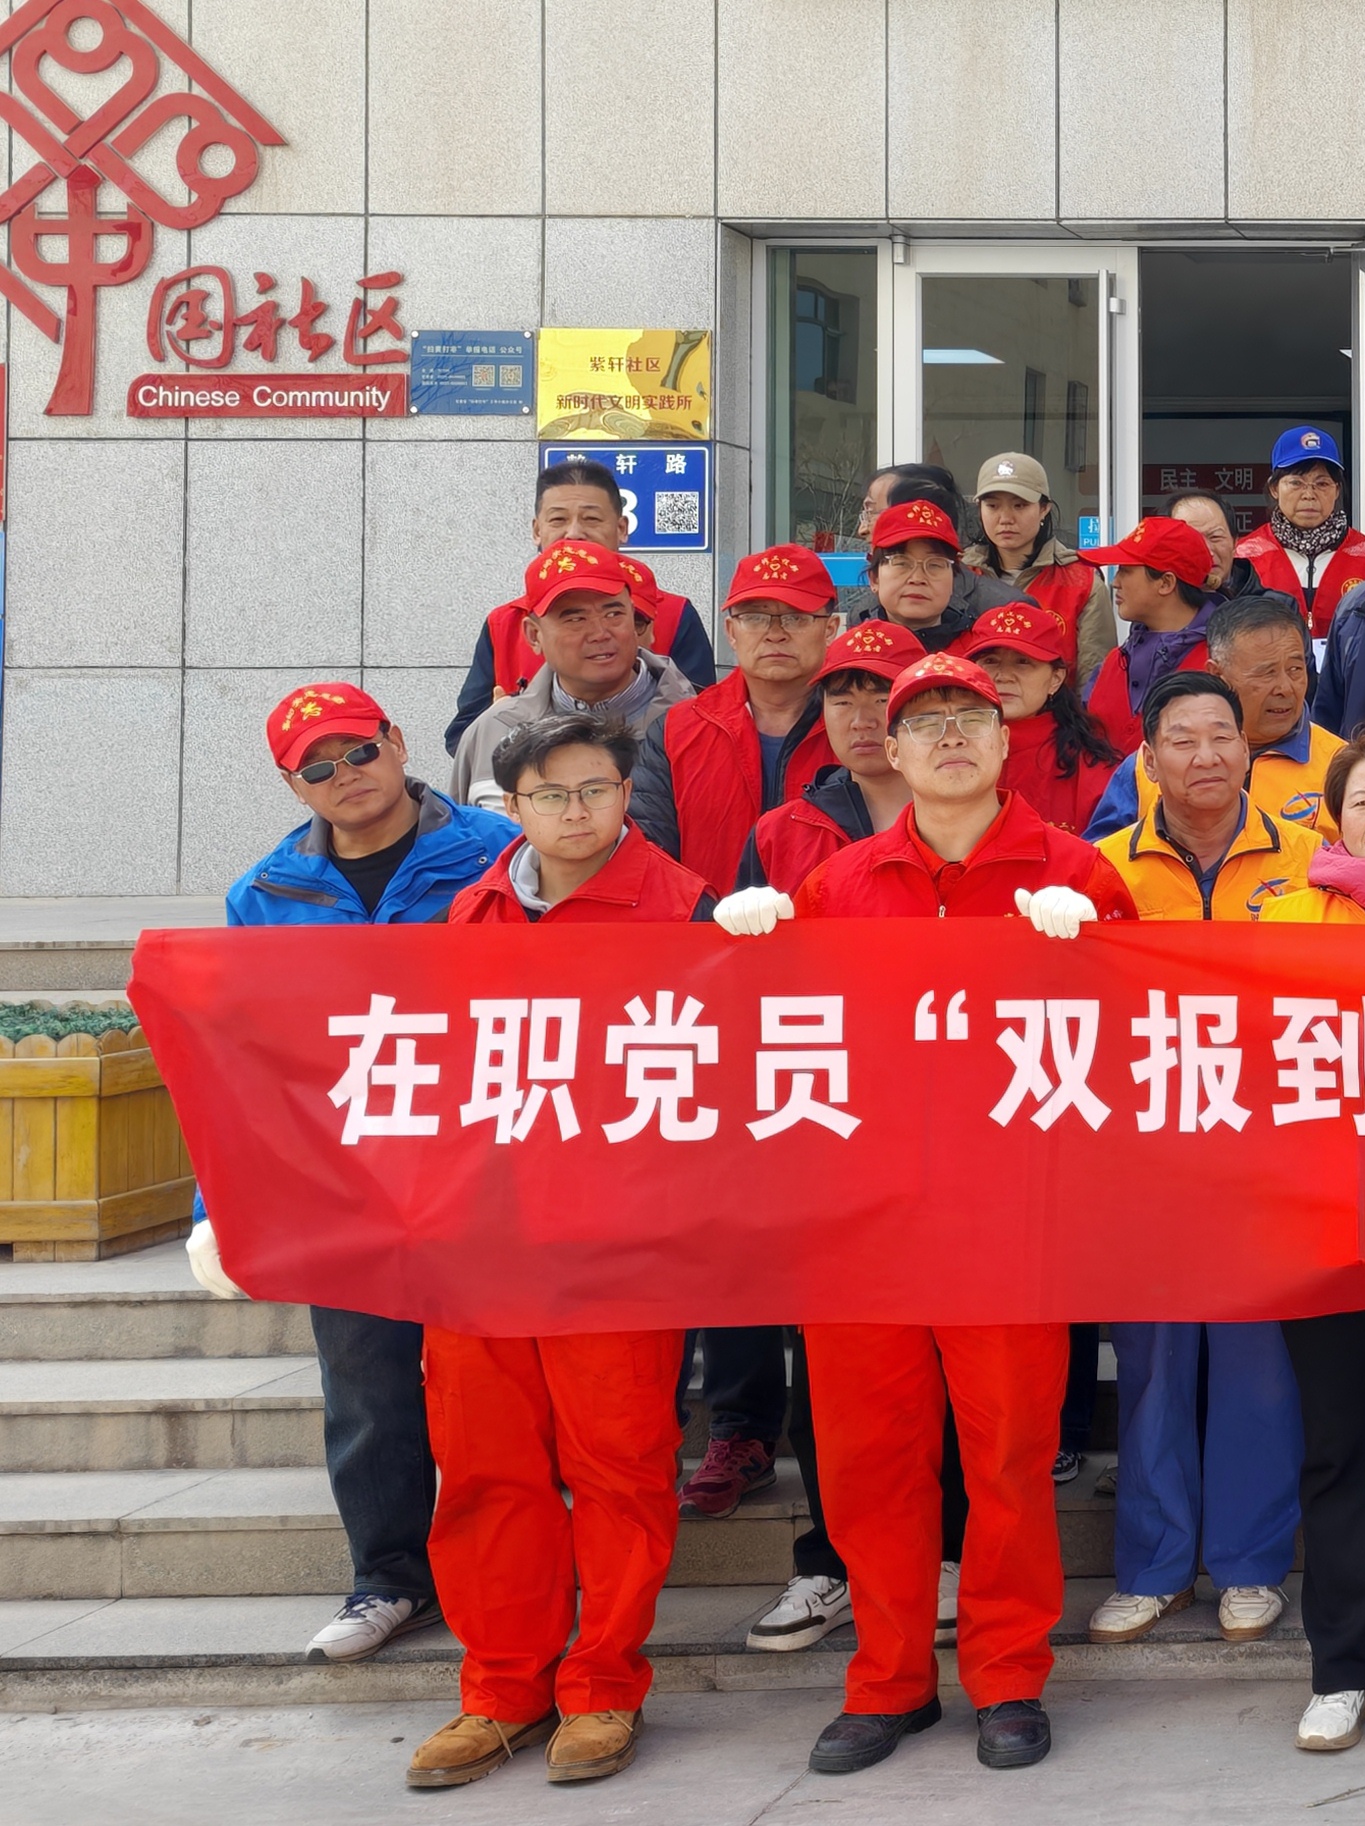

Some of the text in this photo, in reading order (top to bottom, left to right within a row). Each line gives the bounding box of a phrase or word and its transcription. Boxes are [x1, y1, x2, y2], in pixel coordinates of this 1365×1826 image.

[589, 357, 661, 373] 紫轩社区
[138, 385, 391, 412] Chinese Community
[555, 394, 693, 411] 新时代文明实践所
[1160, 467, 1254, 491] 民主 文明
